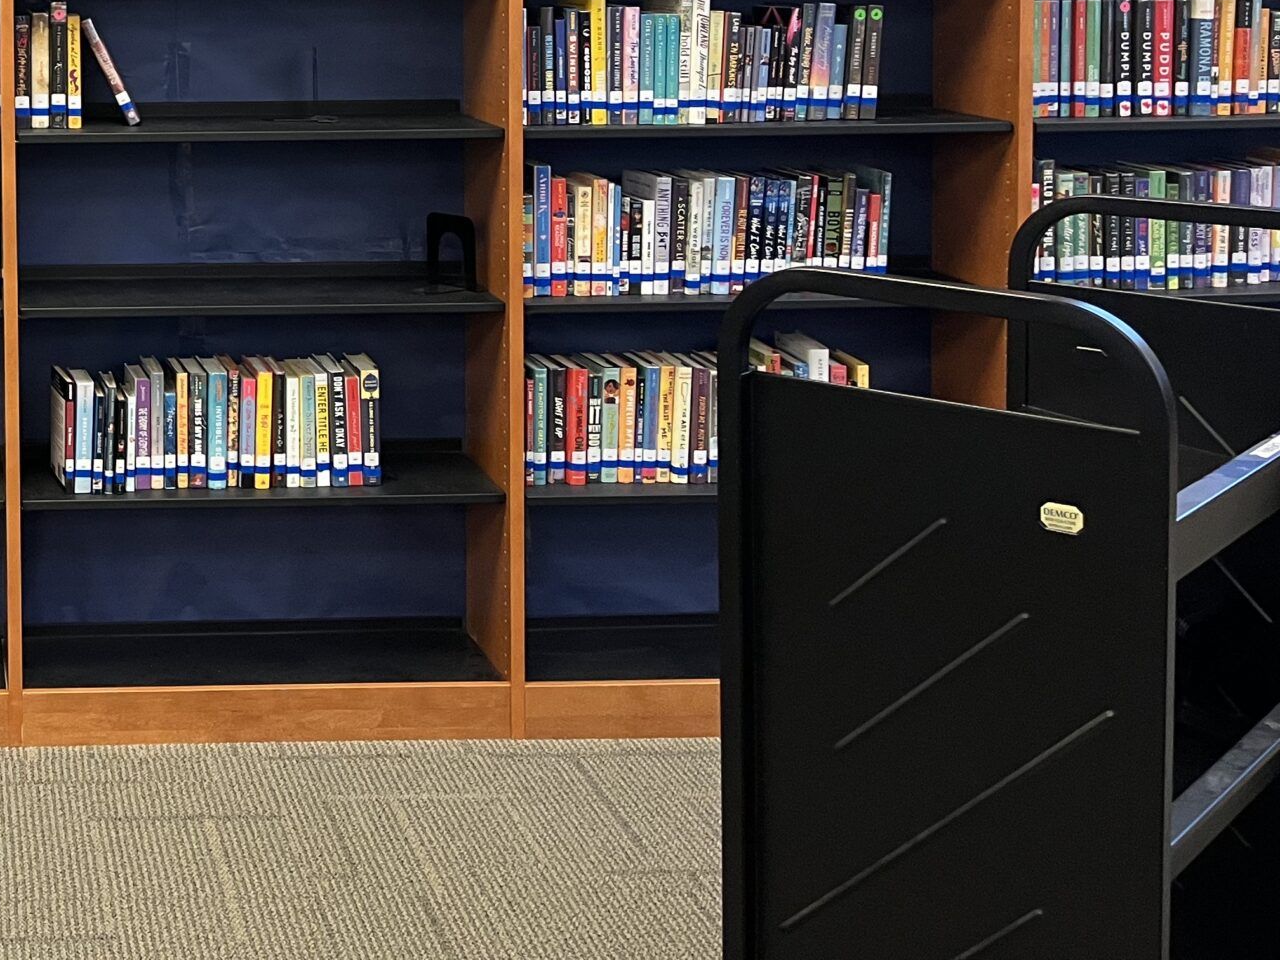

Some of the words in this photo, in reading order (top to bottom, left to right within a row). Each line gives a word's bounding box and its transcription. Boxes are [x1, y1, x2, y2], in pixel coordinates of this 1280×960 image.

[698, 14, 710, 48] LOWLAND
[681, 35, 691, 55] hold
[852, 38, 862, 69] MONUMENT
[1198, 22, 1212, 73] RAMONA
[570, 35, 578, 87] SWINDLE
[629, 56, 637, 84] Loophole
[680, 59, 691, 78] still
[1043, 169, 1053, 197] HELLO
[677, 203, 685, 240] SCATTER
[721, 201, 731, 234] FOREVER
[333, 377, 344, 398] DON'T
[194, 399, 202, 416] THIS
[318, 387, 327, 413] ENTER
[334, 401, 344, 417] ASK
[554, 397, 563, 417] LIGHT
[625, 390, 634, 426] OPHELIA
[195, 426, 202, 437] MY
[306, 413, 315, 435] Silver
[319, 417, 328, 439] TITLE
[555, 428, 563, 438] UP
[335, 428, 345, 447] OKAY
[1043, 507, 1077, 520] DEMCO
